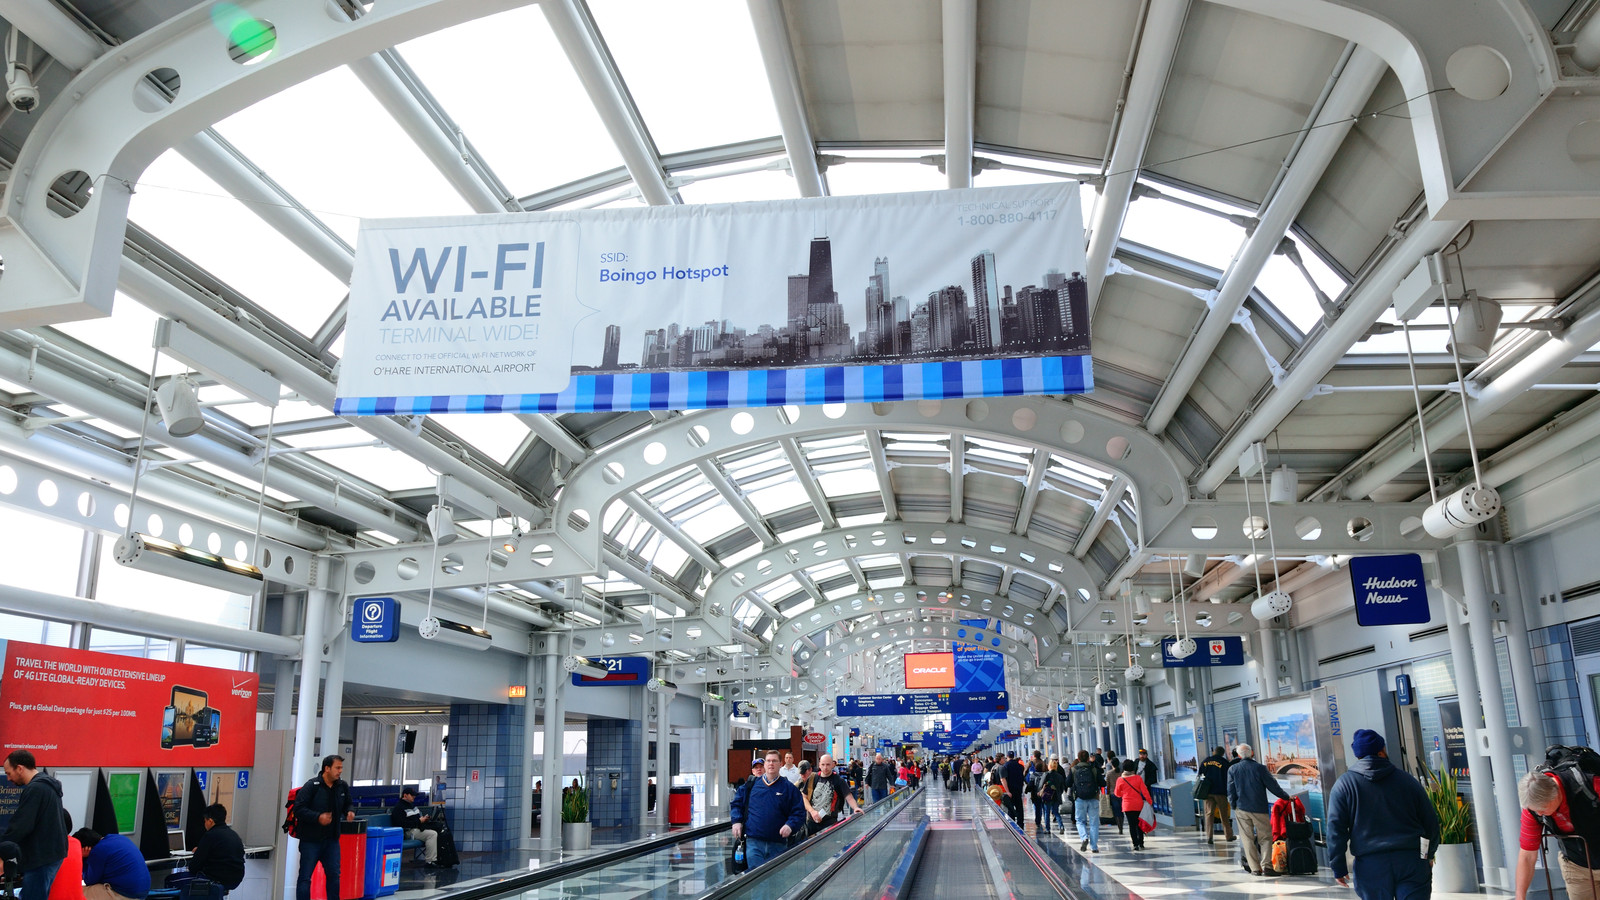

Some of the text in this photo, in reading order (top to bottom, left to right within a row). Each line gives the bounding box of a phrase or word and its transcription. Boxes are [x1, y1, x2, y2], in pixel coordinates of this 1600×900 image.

[957, 198, 1055, 212] TECHNICAL SUPPORT
[958, 210, 1057, 226] 1-800-880-4117
[600, 252, 629, 263] SSID:
[388, 241, 545, 294] WI-FI
[599, 264, 729, 285] Boingo Hotspot
[380, 294, 542, 322] AVAILABLE
[379, 324, 539, 344] TERMINAL WIDE!
[375, 353, 410, 361] CONNECT
[412, 353, 422, 361] TO
[437, 352, 470, 360] OFFICIAL
[471, 351, 488, 359] WI-FI
[489, 351, 525, 359] NETWORK
[373, 363, 536, 376] O'HARE INTERNATIONAL AIRPORT
[1362, 576, 1418, 590] Hudson
[1365, 591, 1408, 605] News
[16, 657, 166, 682] TRAVEL THE WORLD WITH OUR EXTENSIVE LINEUP
[599, 659, 622, 671] 21
[13, 669, 126, 690] OF 4G LTE GLOBAL-READY DEVICES.
[231, 688, 252, 698] verizon
[510, 686, 525, 696] EXIT
[9, 701, 22, 711] Plus,
[22, 703, 32, 712] get
[36, 703, 54, 712] Global
[54, 705, 65, 713] Data
[65, 706, 86, 716] package
[93, 708, 103, 716] just
[1327, 694, 1342, 736] WOMEN
[4, 743, 58, 751] verizonwireless.com/global
